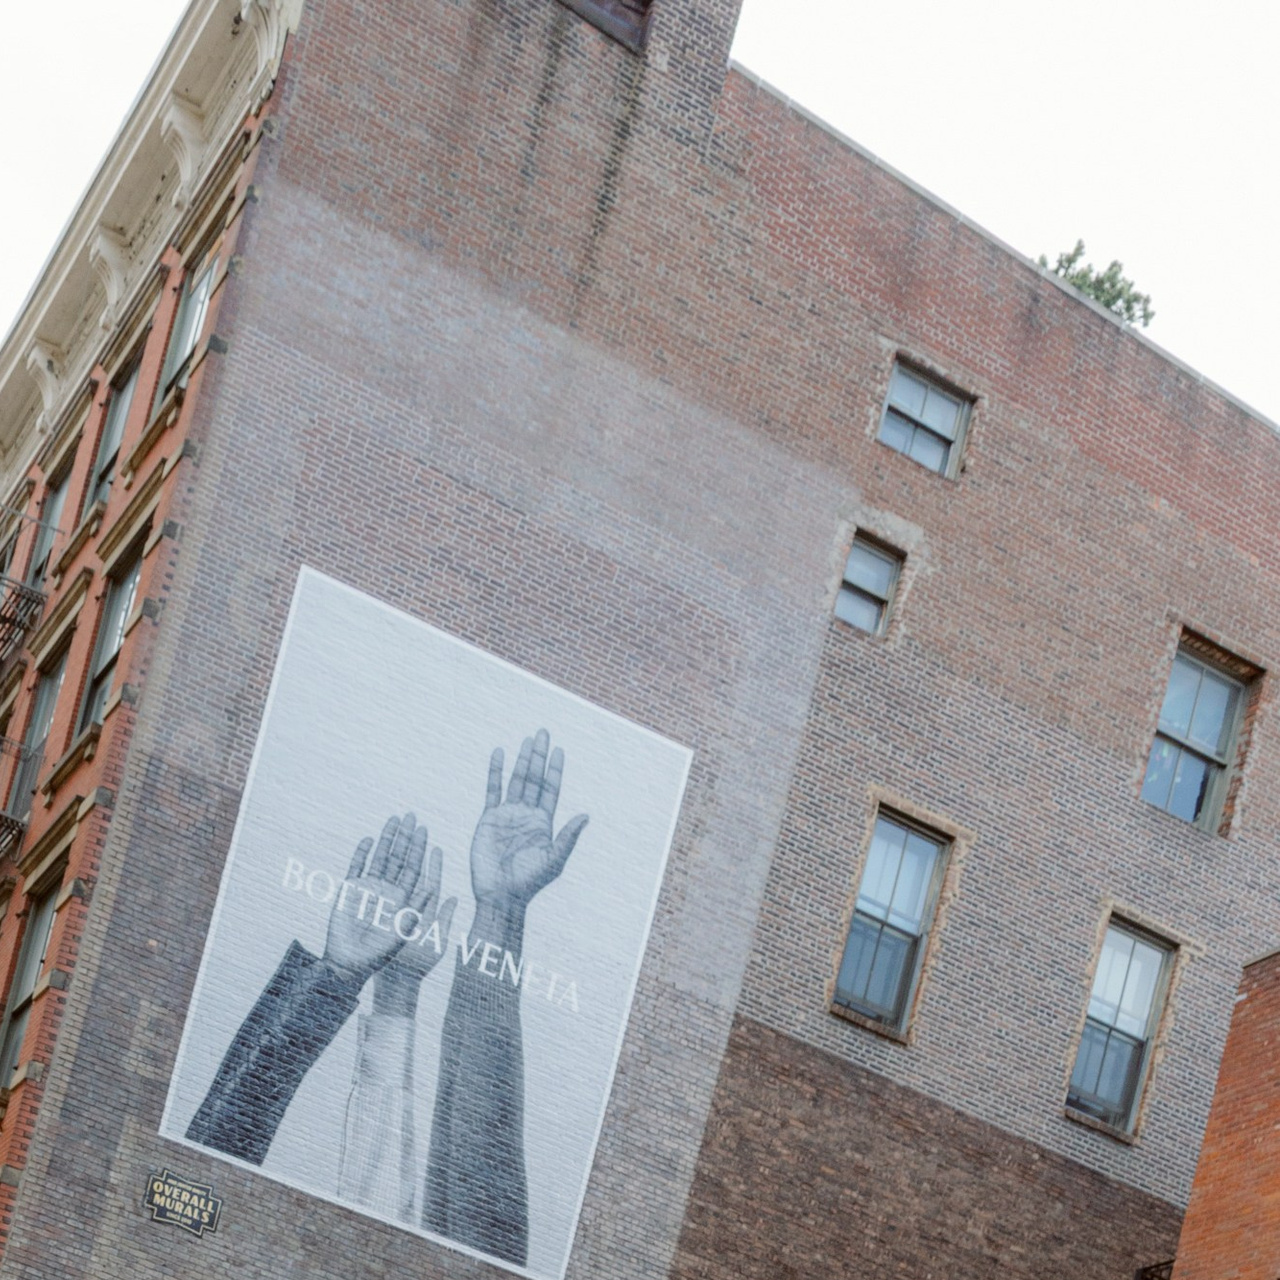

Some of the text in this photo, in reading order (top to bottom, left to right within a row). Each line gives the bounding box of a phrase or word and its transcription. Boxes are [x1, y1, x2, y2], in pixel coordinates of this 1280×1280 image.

[282, 857, 581, 1013] BOTTEGA VENETA
[152, 1181, 215, 1214] OVERALL
[152, 1193, 211, 1223] MURALS
